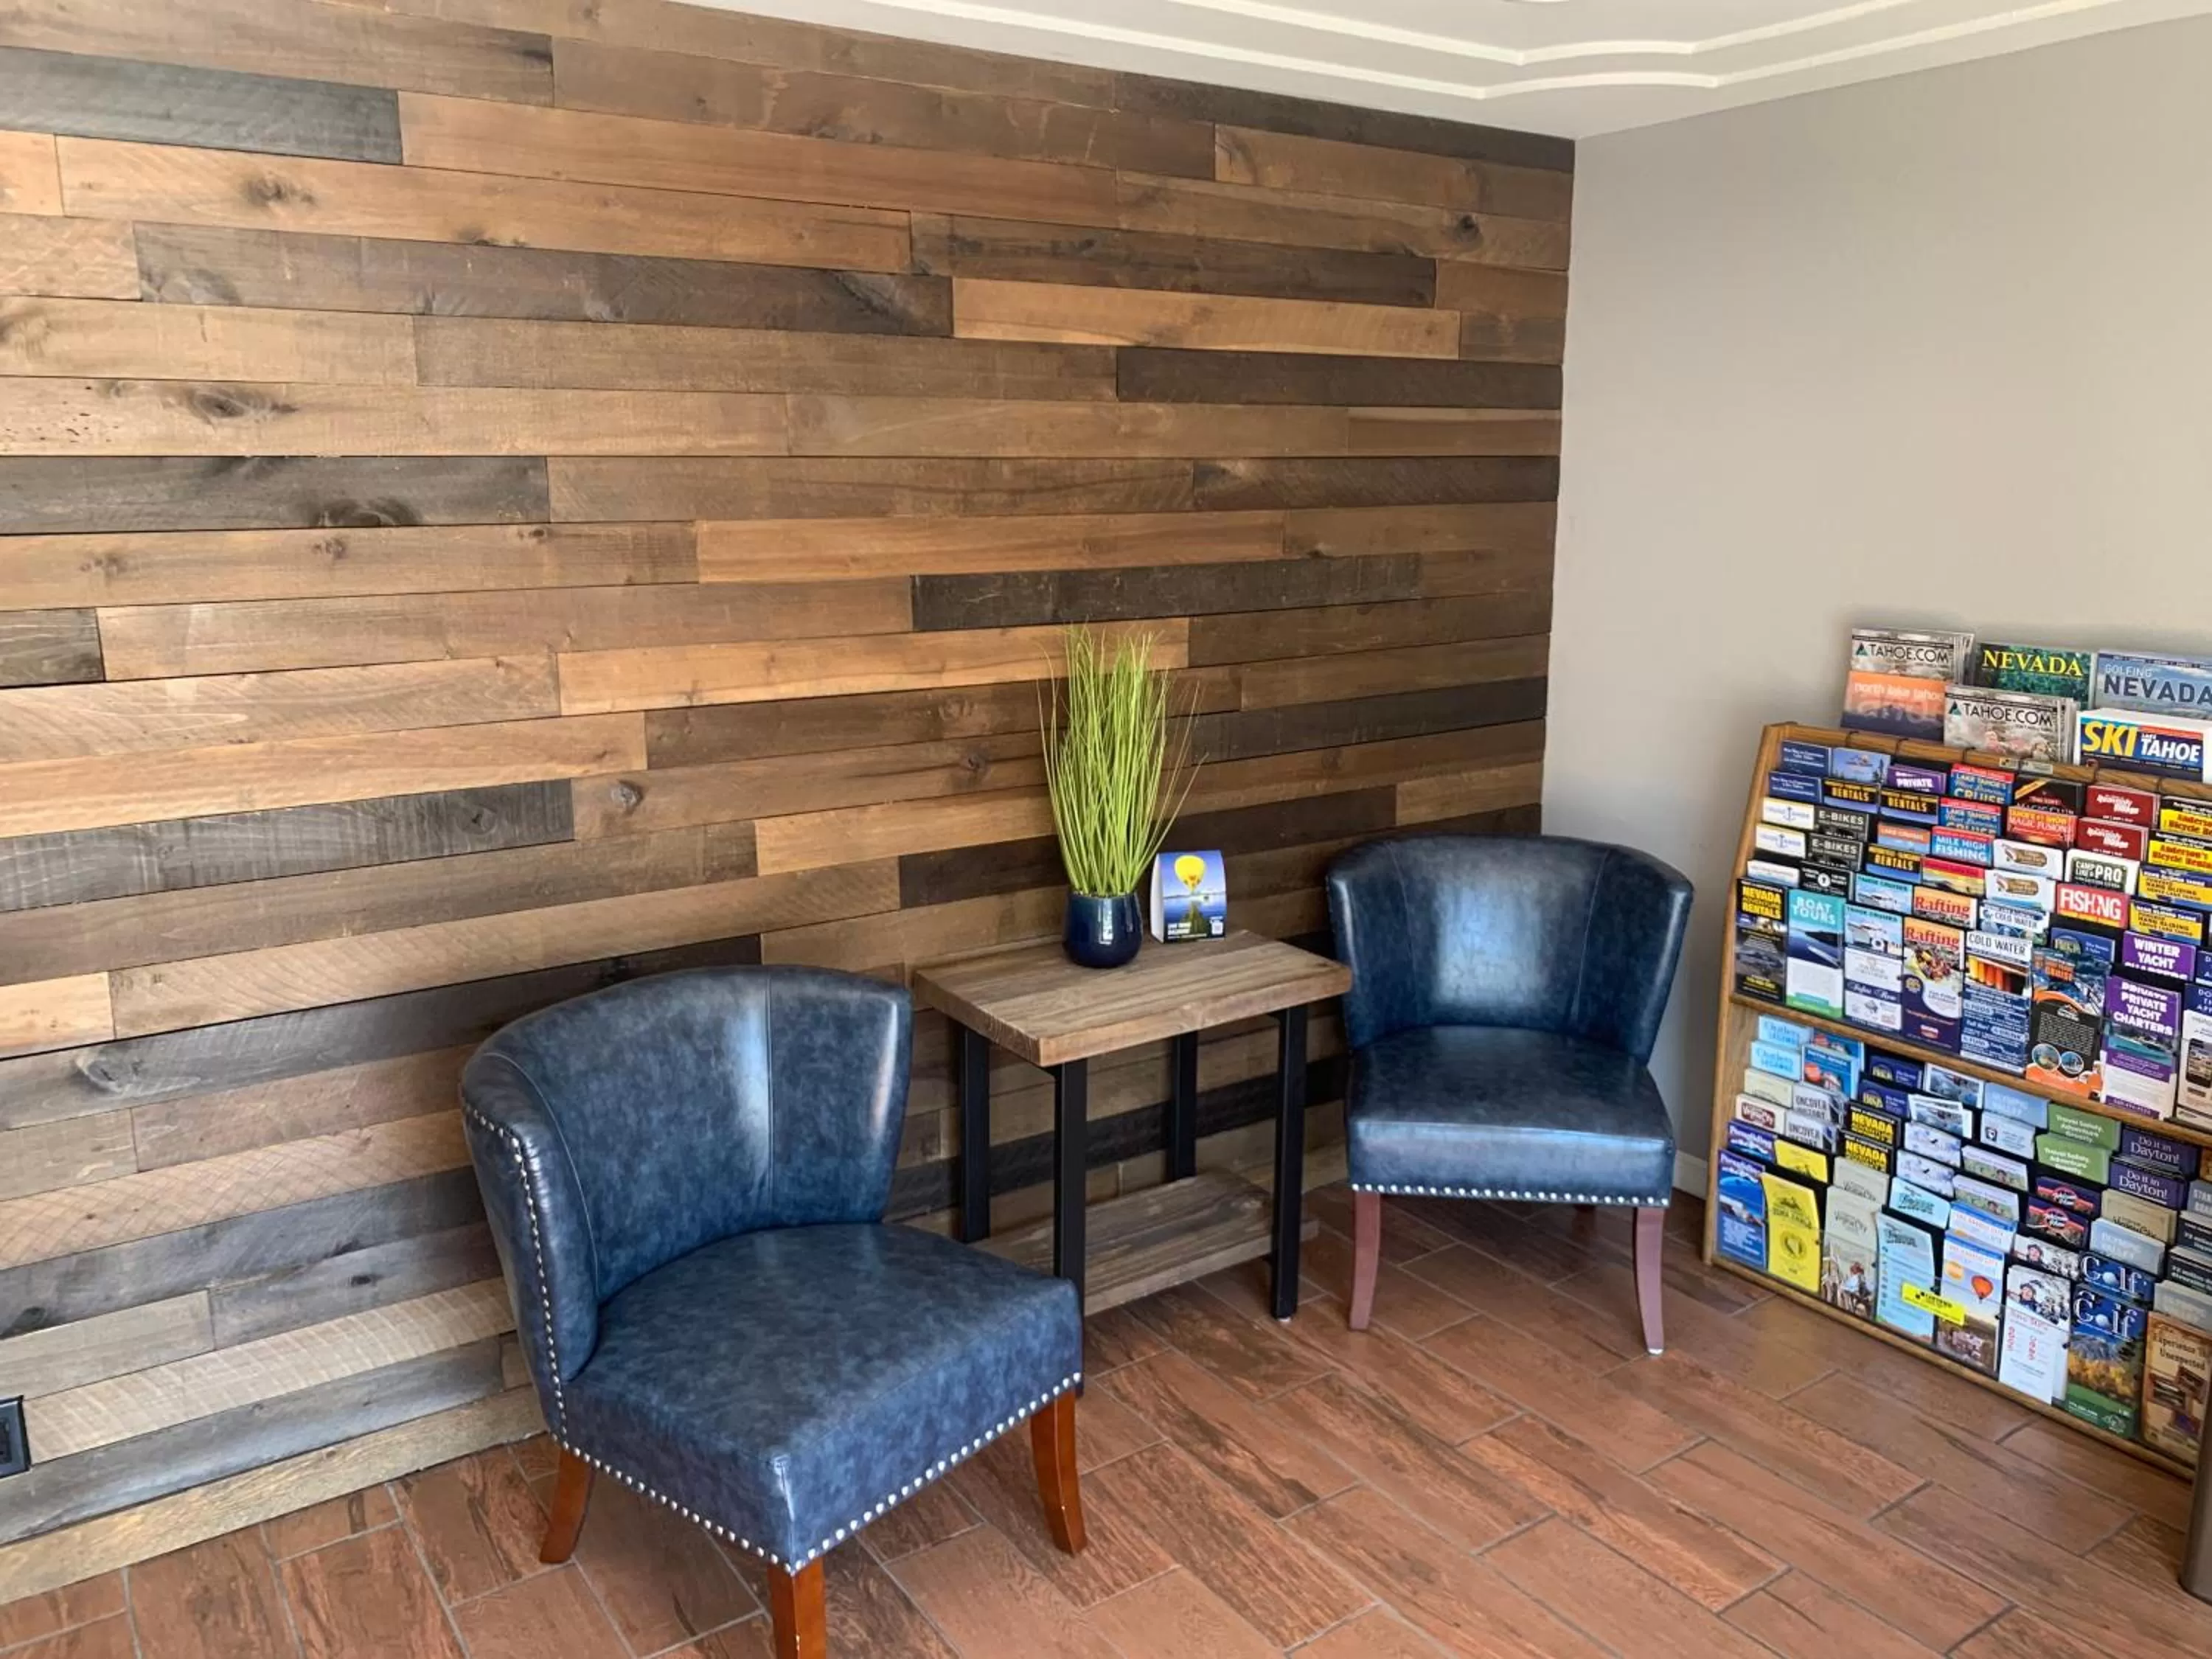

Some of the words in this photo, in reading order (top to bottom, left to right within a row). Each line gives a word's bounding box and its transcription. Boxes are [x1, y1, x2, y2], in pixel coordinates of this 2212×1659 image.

[1868, 644, 1950, 663] TAHOE.COM
[1982, 650, 2083, 677] NEVADA
[2105, 664, 2153, 677] GOLFING
[1854, 683, 1885, 694] north
[2104, 675, 2212, 706] NEVADA
[1964, 703, 2053, 727] TAHOE.COM
[2082, 721, 2138, 757] SKI
[2141, 737, 2201, 762] TAHOE
[1896, 778, 1934, 788] PRIVATE
[1832, 787, 1870, 801] RENTALS
[1888, 797, 1928, 812] RENTALS
[1818, 810, 1864, 825] E-BIKES
[1812, 838, 1857, 855] E-BIKES
[1936, 836, 1959, 846] MILE
[1962, 839, 1986, 849] HIGH
[1935, 845, 1986, 861] FISHING
[1875, 855, 1913, 870] RENTALS
[2076, 861, 2096, 872] CAMP
[2096, 865, 2123, 883] PRO
[1742, 886, 1781, 902] NEVADA
[1742, 902, 1781, 919] RENTALS
[1796, 897, 1832, 914] BOAT
[1915, 896, 1971, 919] Rafting
[1792, 905, 1835, 925] TOURS
[1994, 912, 2011, 922] COLD
[1905, 926, 1959, 950] Rafting
[1968, 933, 1992, 947] COLD
[1994, 938, 2026, 956] WATER
[2133, 937, 2180, 958] WINTER
[2138, 952, 2176, 970] YACHT
[2121, 992, 2168, 1012] PRIVATE
[2126, 1004, 2162, 1021] YACHT
[2113, 1011, 2174, 1036] CHARTERS
[1795, 1096, 1826, 1110] UNCOVER
[1788, 1122, 1820, 1136] UNCOVER
[1851, 1110, 1893, 1133] NEVADA
[1845, 1138, 1887, 1161] NEVADA
[2139, 1136, 2152, 1147] Do
[2154, 1139, 2160, 1148] it
[2163, 1143, 2171, 1152] in
[2130, 1143, 2180, 1164] Dayton!
[2118, 1175, 2168, 1198] Dayton!
[2127, 1170, 2140, 1180] Do
[2142, 1173, 2149, 1182] it
[2151, 1178, 2160, 1186] in
[2160, 1348, 2206, 1371] Unexpected
